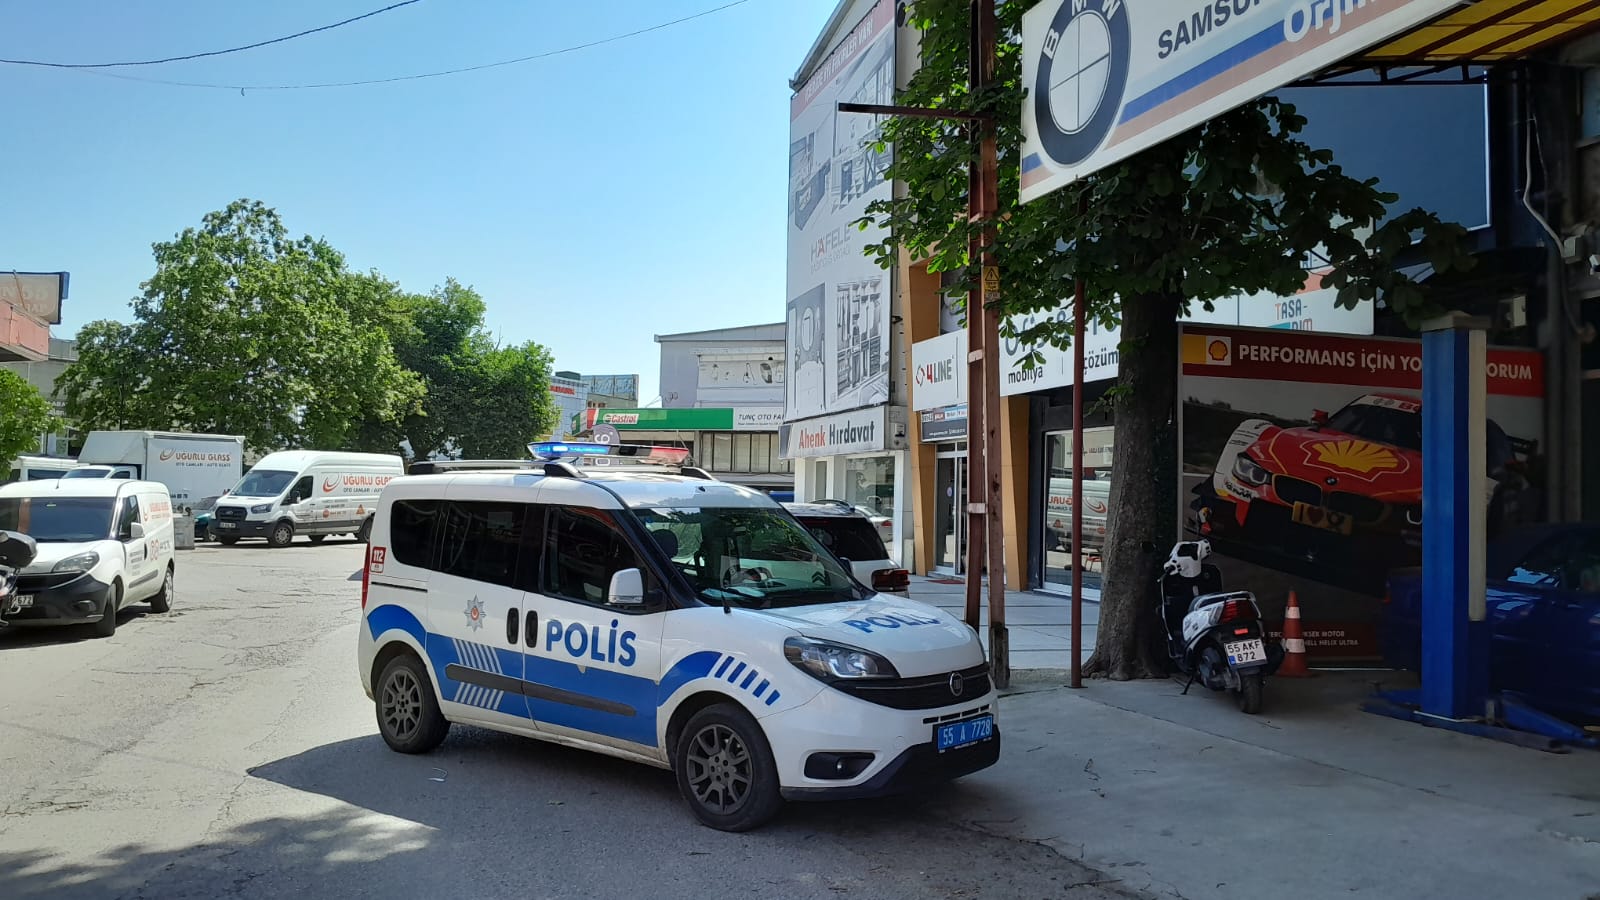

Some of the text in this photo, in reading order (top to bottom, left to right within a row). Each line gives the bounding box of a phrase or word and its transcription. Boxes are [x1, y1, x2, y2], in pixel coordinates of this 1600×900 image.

[1158, 0, 1265, 59] SAMSU
[1239, 344, 1356, 368] PERFORMANS
[1360, 348, 1396, 374] İÇİN
[1486, 361, 1533, 381] ORUM
[611, 413, 637, 424] Castrol
[739, 414, 756, 422] TUNÇ
[799, 419, 875, 449] Ahenk Hırdavat
[207, 453, 231, 462] GLASS
[373, 550, 384, 562] 112
[842, 611, 941, 634] POLİS
[545, 617, 637, 667] POLİS
[1227, 640, 1261, 654] 55 AKF
[1236, 652, 1256, 662] 872
[943, 727, 954, 746] 55
[959, 725, 966, 742] A
[971, 720, 991, 740] 7728
